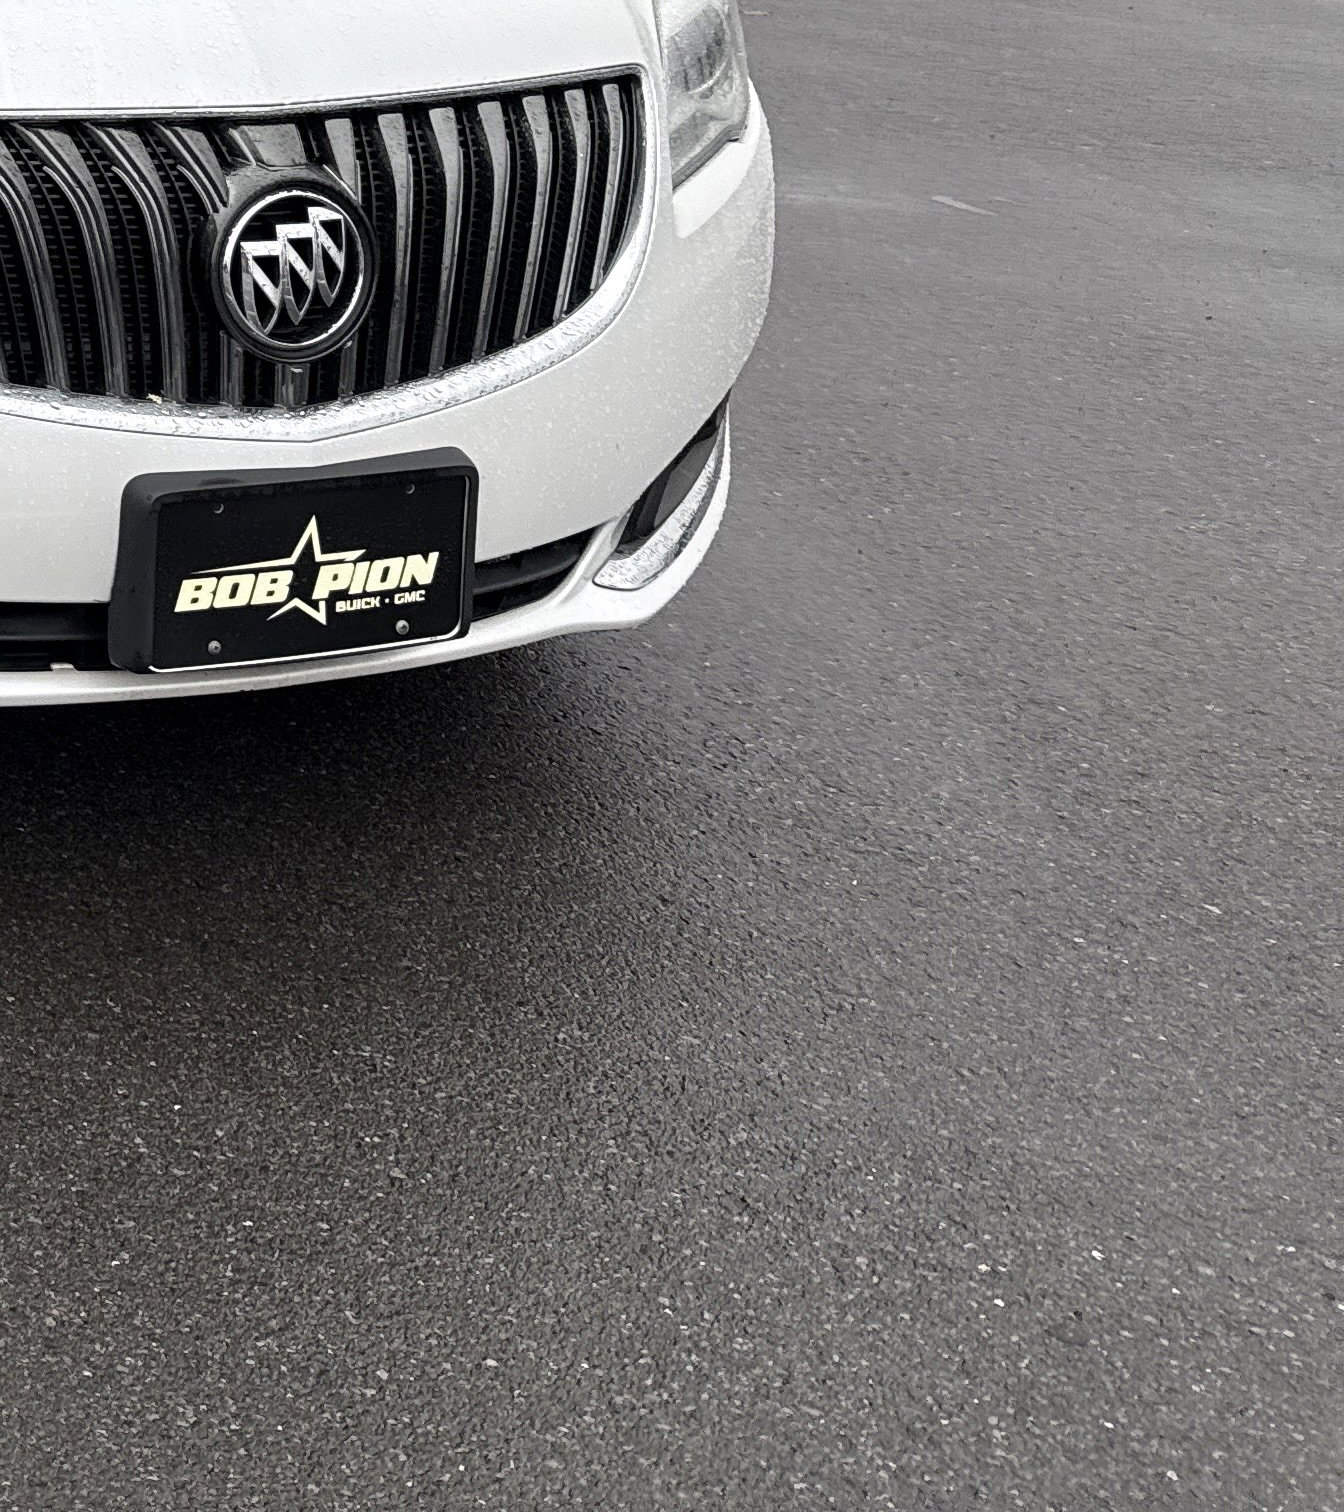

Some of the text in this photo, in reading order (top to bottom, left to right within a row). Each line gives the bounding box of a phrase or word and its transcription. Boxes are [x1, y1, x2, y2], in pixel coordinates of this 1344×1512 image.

[174, 552, 439, 612] BOB PION
[336, 590, 426, 613] BUICK GMC
